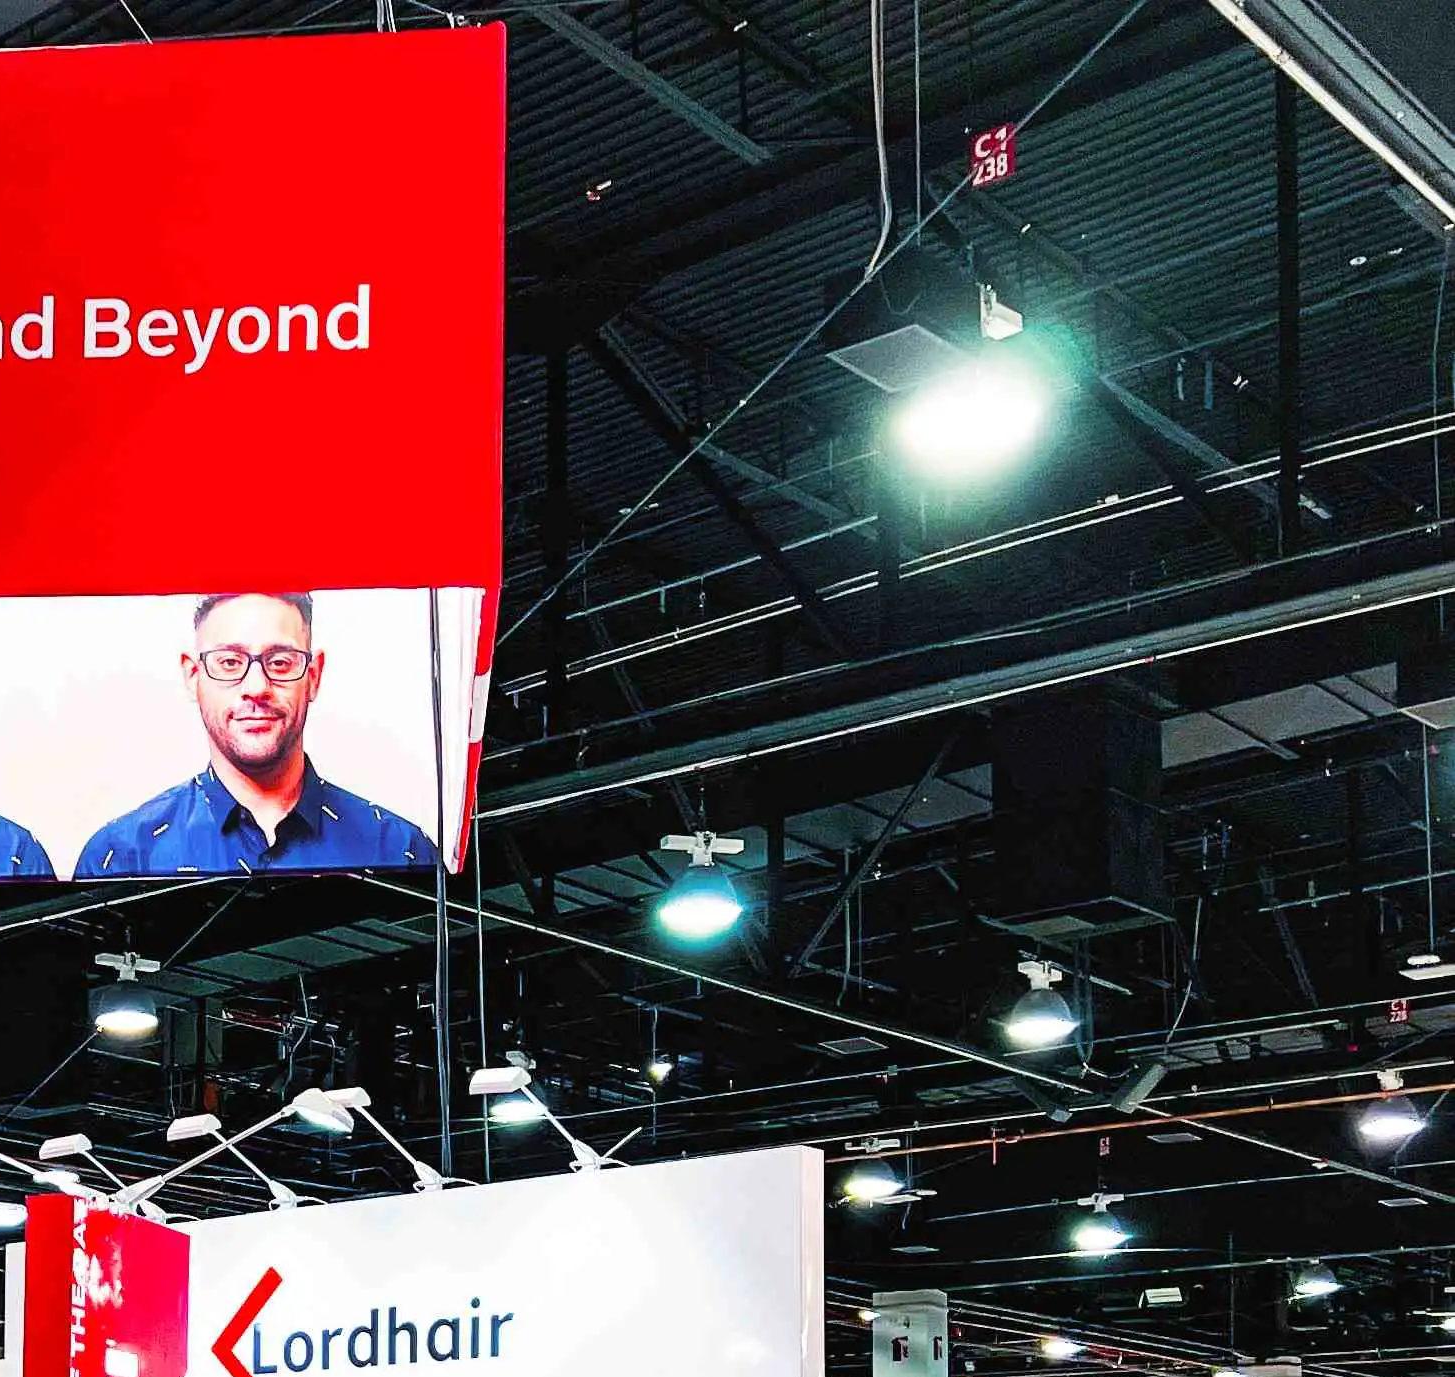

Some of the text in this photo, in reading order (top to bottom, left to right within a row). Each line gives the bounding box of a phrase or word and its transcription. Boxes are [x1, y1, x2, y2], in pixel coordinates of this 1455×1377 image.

[83, 283, 371, 374] Beyond
[70, 1284, 87, 1359] THE
[253, 1296, 515, 1375] Lordhair
